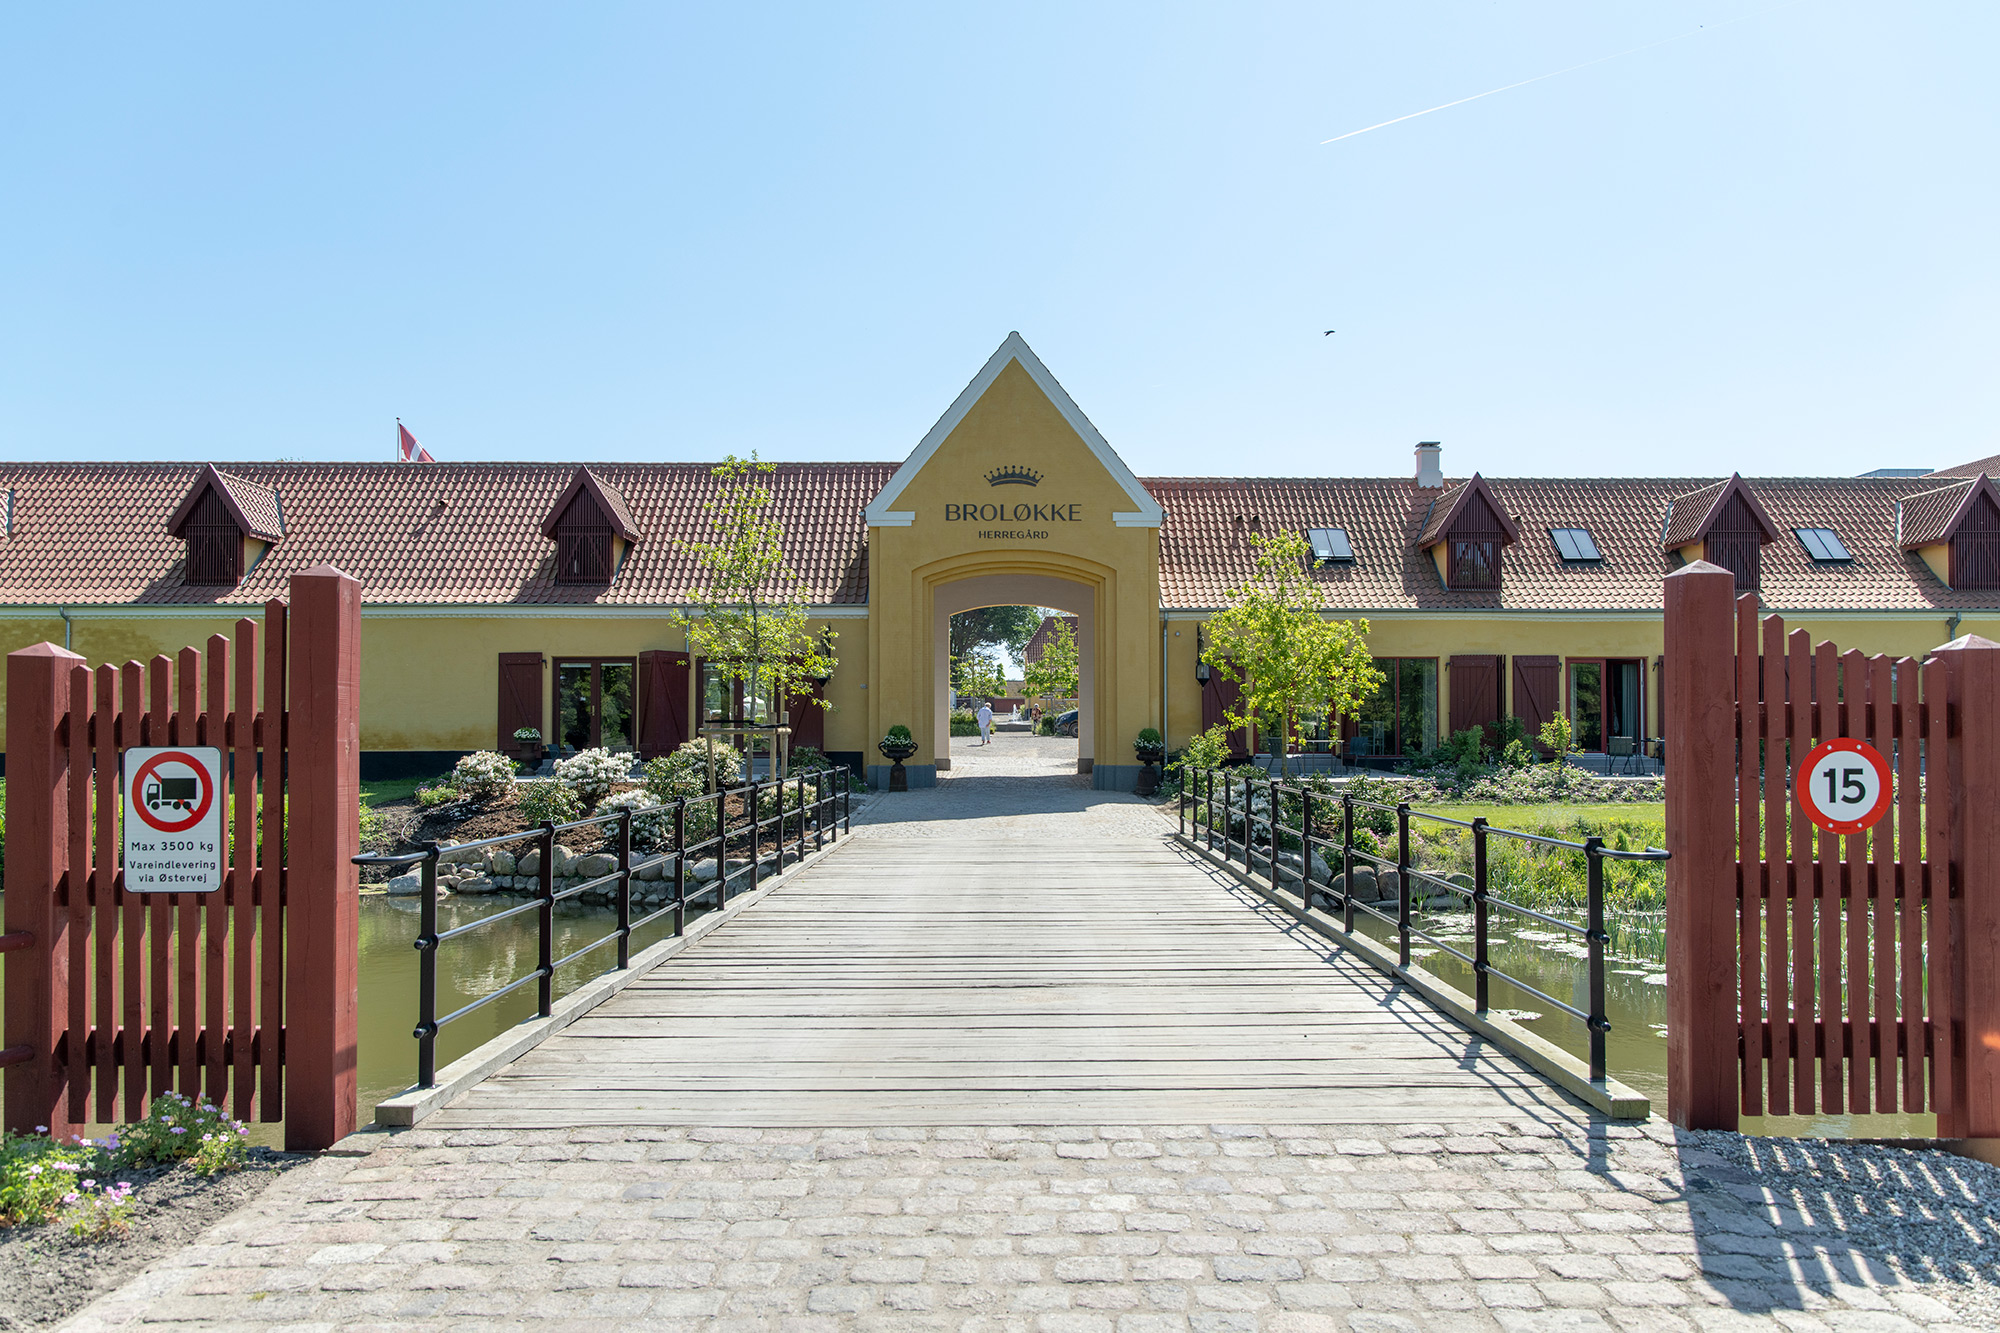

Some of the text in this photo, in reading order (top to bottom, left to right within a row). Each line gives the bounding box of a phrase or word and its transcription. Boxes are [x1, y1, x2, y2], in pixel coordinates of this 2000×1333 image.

[945, 503, 1082, 522] BROLØKKE
[978, 529, 1049, 539] HERREGÅRD
[1822, 767, 1867, 804] 15
[131, 841, 214, 852] Max 3500 kg
[129, 860, 216, 870] Vareindlevering
[138, 873, 207, 883] via Østervej
